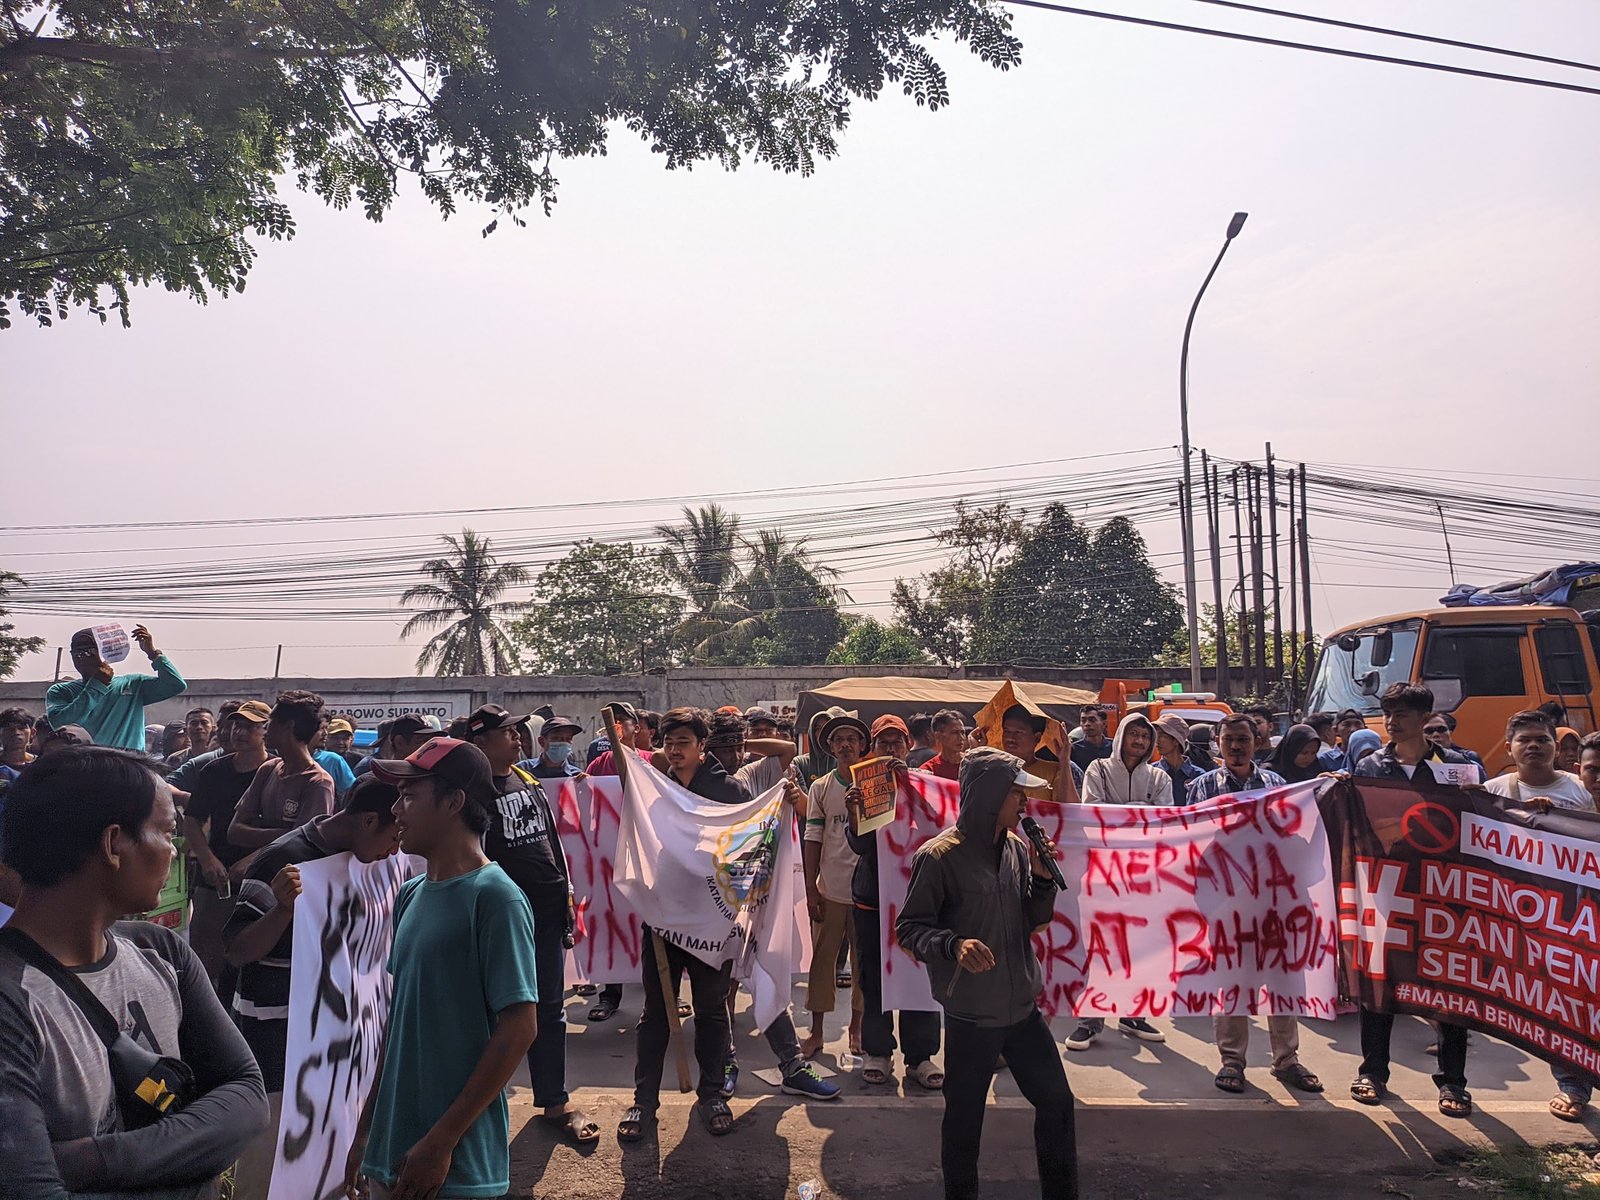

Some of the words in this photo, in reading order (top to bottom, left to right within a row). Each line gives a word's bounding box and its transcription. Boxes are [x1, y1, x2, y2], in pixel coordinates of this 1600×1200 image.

[1086, 842, 1299, 905] MERANA
[1470, 822, 1544, 866] KAMI
[1424, 863, 1600, 944] MENOLA
[1424, 906, 1515, 960] DAN
[1396, 983, 1480, 1018] #MAHA
[1485, 1007, 1545, 1046] BENAR
